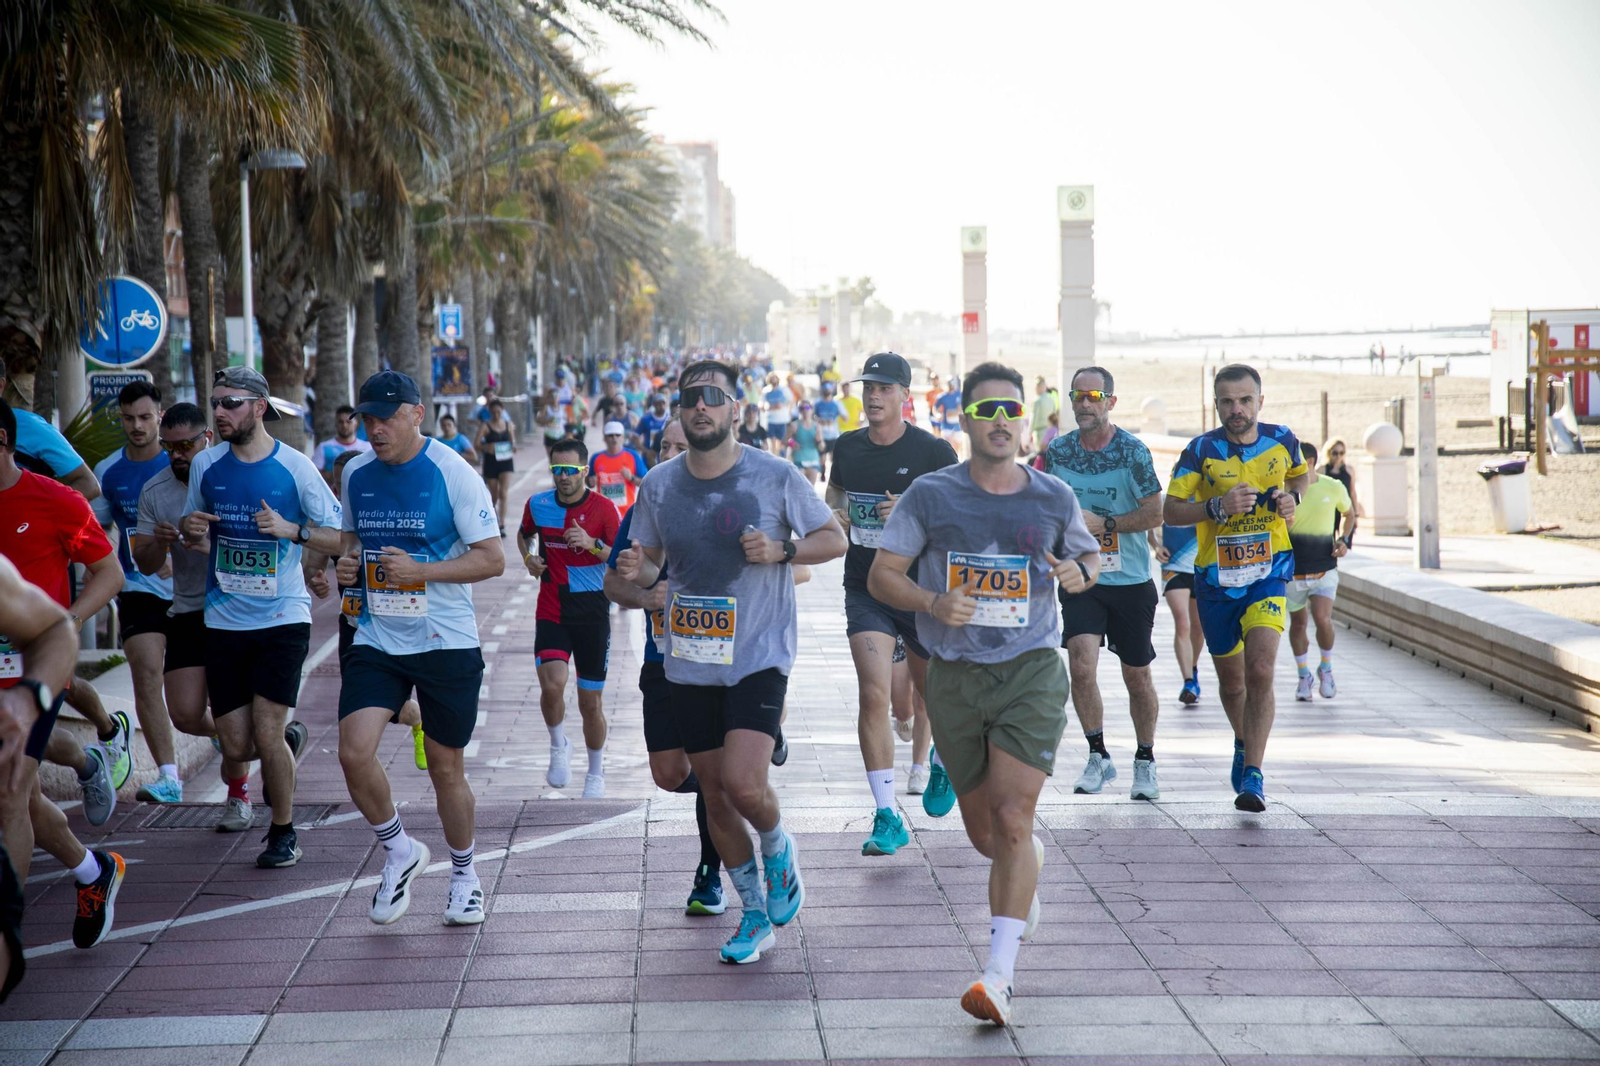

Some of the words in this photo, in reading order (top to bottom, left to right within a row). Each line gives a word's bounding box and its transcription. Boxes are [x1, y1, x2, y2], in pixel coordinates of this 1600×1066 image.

[213, 502, 238, 511] Medio
[241, 504, 279, 514] Maran
[358, 510, 385, 518] Medio
[387, 510, 427, 519] Maratón
[856, 504, 880, 521] 34
[358, 519, 395, 529] Almería
[396, 519, 426, 530] 2025
[1243, 523, 1266, 532] EJIDO
[223, 549, 271, 568] 1053
[1224, 542, 1267, 561] 1054
[958, 567, 1022, 591] 1705
[675, 608, 729, 630] 2606
